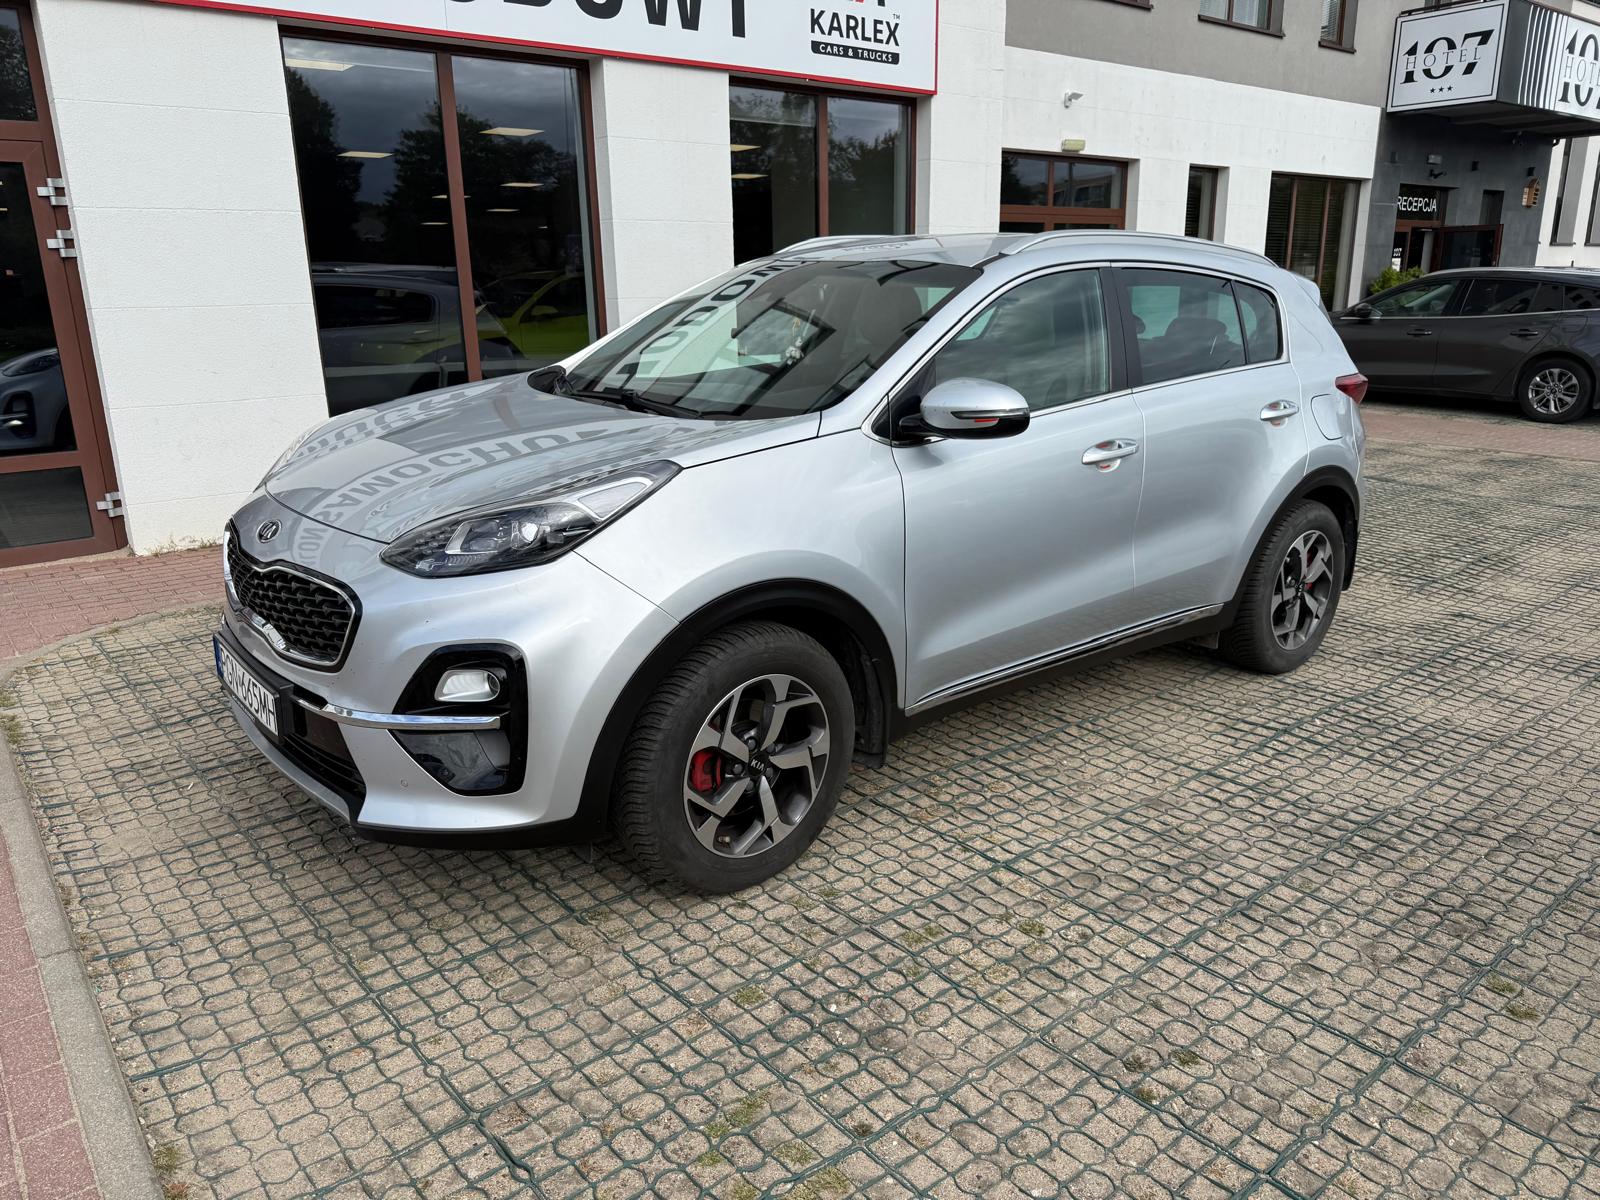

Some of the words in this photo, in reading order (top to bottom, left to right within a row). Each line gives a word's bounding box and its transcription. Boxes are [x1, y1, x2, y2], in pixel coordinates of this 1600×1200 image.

[810, 8, 900, 46] KARLEX
[820, 44, 844, 55] CARS
[848, 48, 854, 57] &
[858, 49, 892, 62] TRUCKS
[1400, 29, 1495, 84] 107
[1406, 47, 1481, 70] HOTEL
[1558, 29, 1600, 109] 10
[1397, 196, 1437, 212] RECEPCJA
[241, 672, 277, 733] 665MH
[750, 759, 764, 771] KIA
